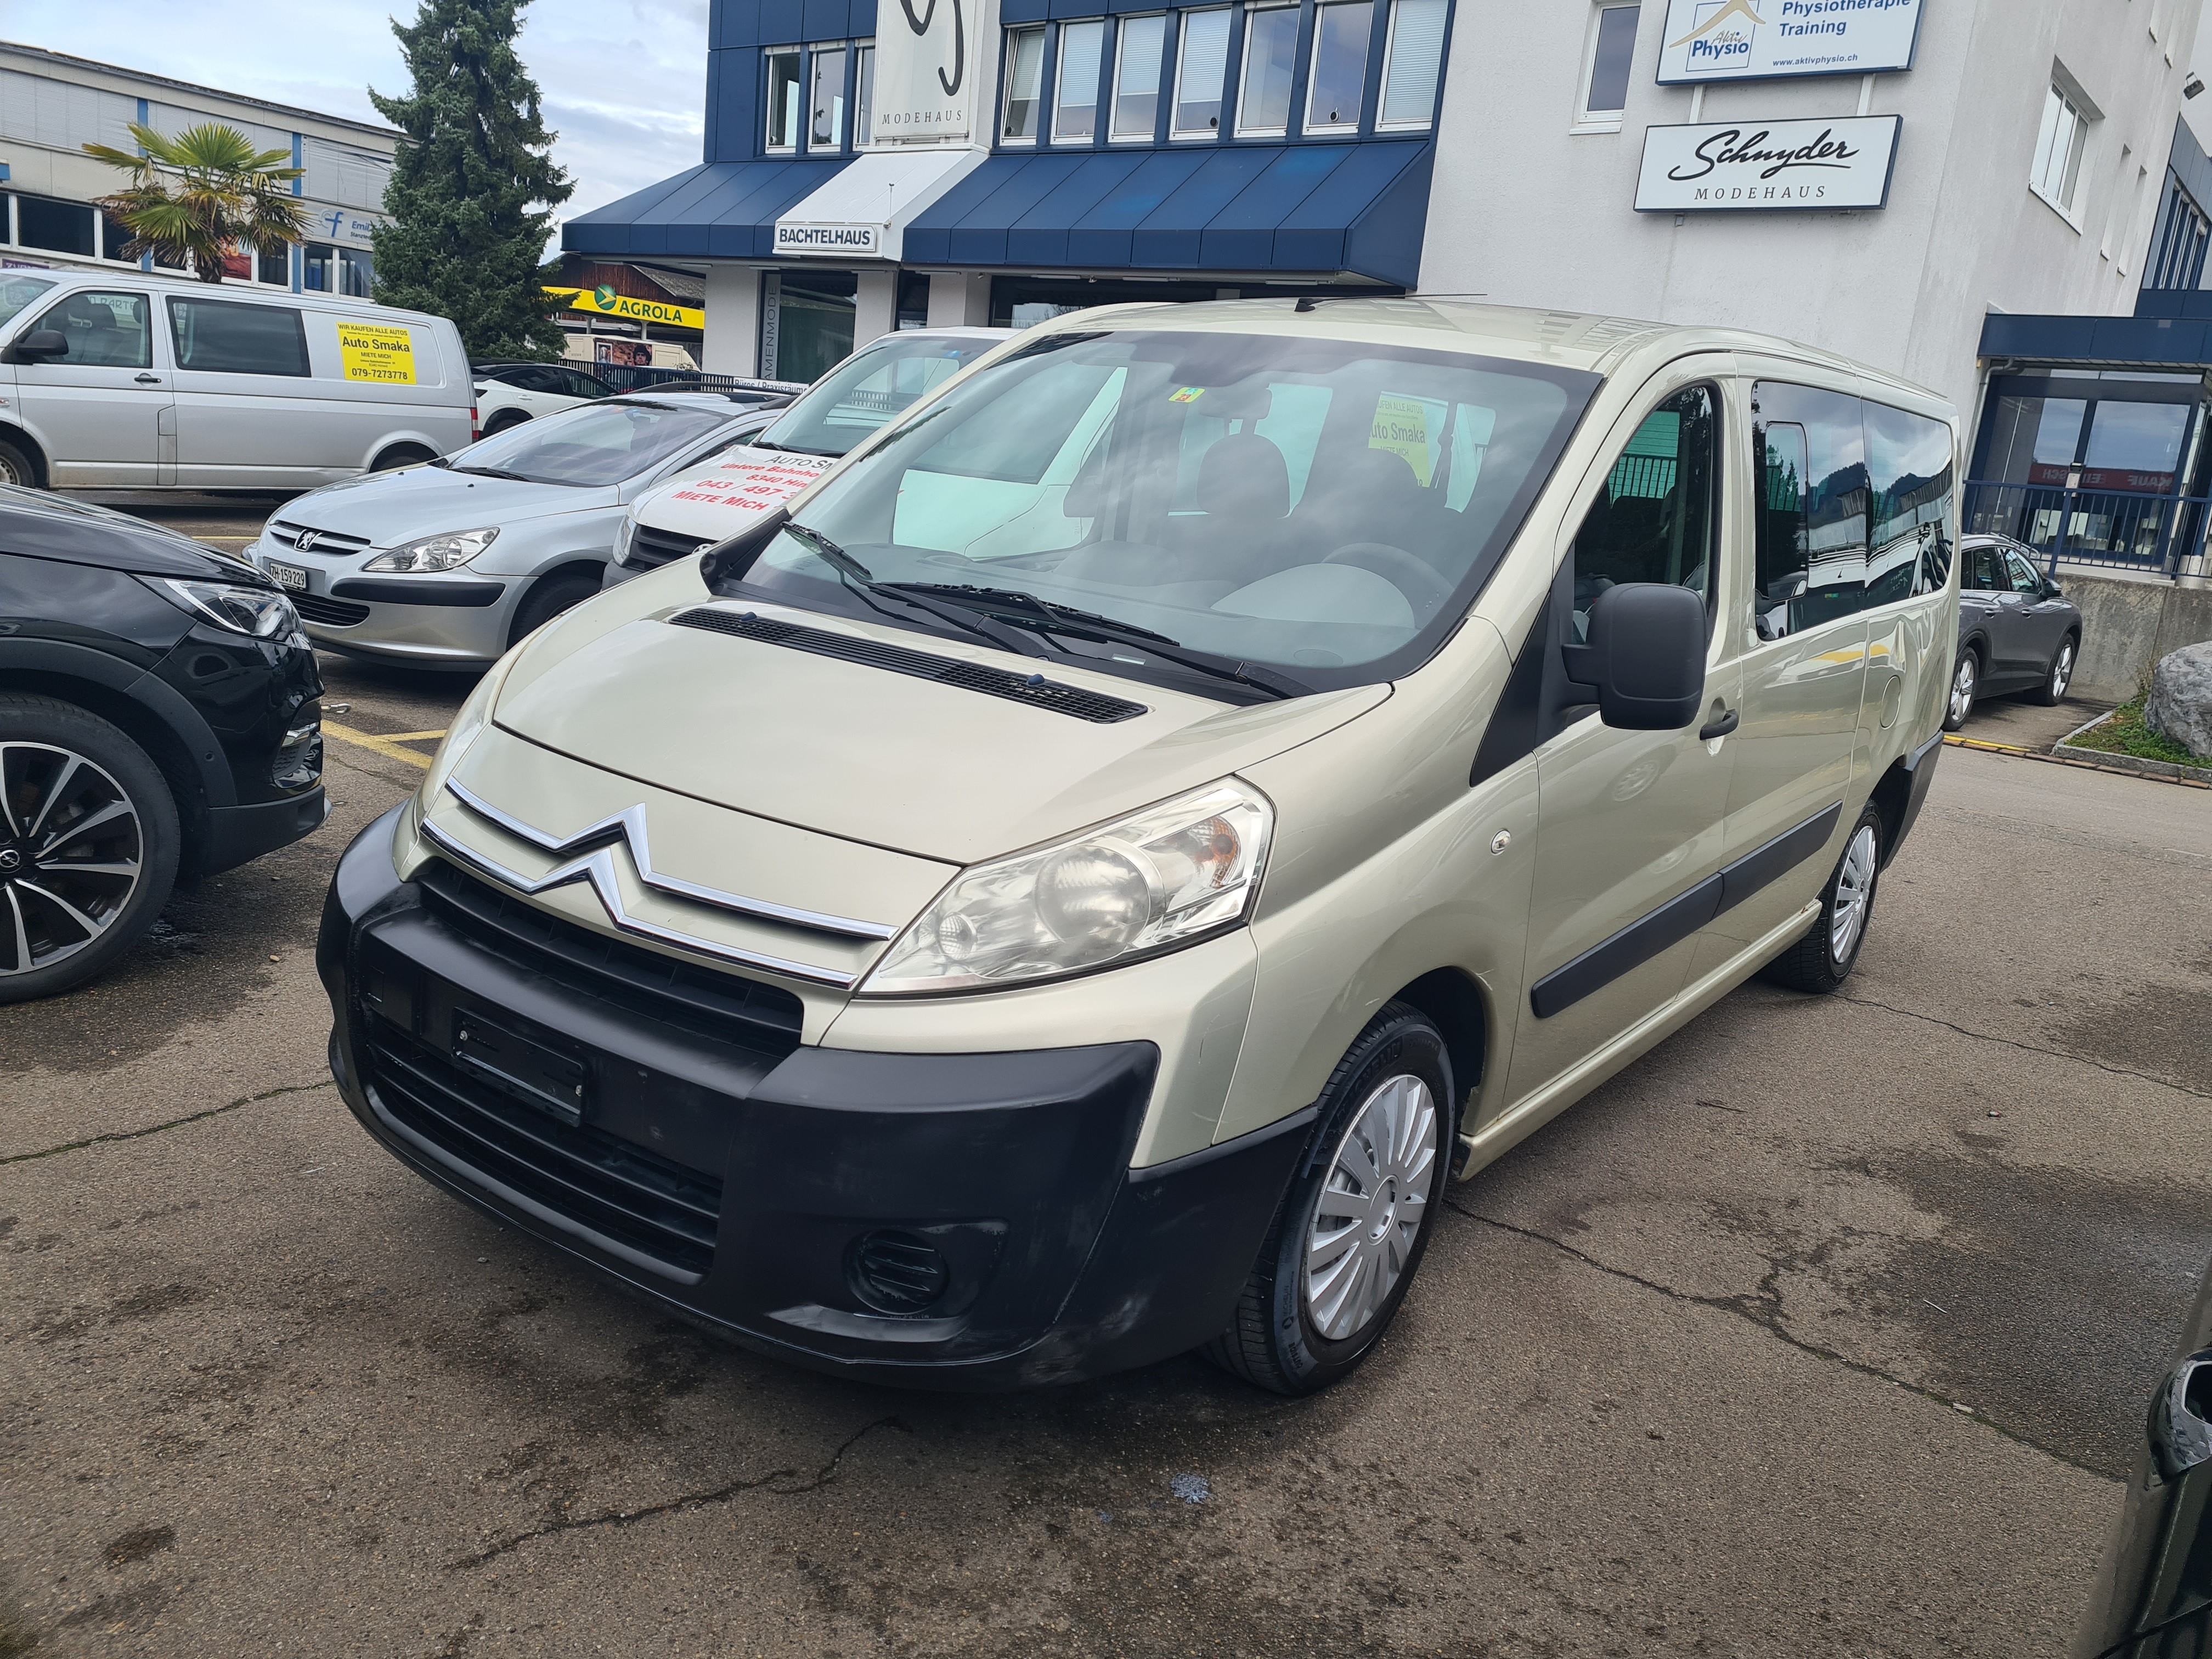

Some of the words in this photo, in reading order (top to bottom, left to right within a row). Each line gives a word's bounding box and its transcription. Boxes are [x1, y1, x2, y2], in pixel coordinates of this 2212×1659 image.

[1779, 20, 1847, 37] Training
[1710, 30, 1748, 44] Aktiv
[1691, 38, 1749, 60] Physio
[1772, 53, 1858, 66] www.aktivphysio.ch
[882, 110, 962, 125] MODEHAUS
[1667, 128, 1860, 180] Schnyder
[1694, 185, 1825, 200] MODEHAUS
[352, 221, 370, 231] Emil
[779, 228, 871, 245] BACHTELHAUS
[619, 300, 682, 323] AGROLA
[764, 285, 777, 380] AMENMODE
[342, 336, 369, 348] Auto
[371, 338, 410, 352] Smaka
[352, 368, 408, 380] 079-7273778
[1393, 402, 1406, 412] ALLE
[1406, 403, 1423, 414] AUTOS
[1371, 422, 1389, 439] uto
[1391, 422, 1426, 444] Smaka
[764, 455, 812, 467] AUTO
[811, 459, 833, 470] SM
[767, 466, 820, 478] Bahnho
[745, 473, 783, 484] 8340
[781, 478, 809, 488] Hin
[695, 479, 734, 489] 043
[742, 484, 785, 496] 497
[781, 491, 797, 500] 3
[670, 490, 724, 503] MIETE
[720, 496, 770, 511] MICH
